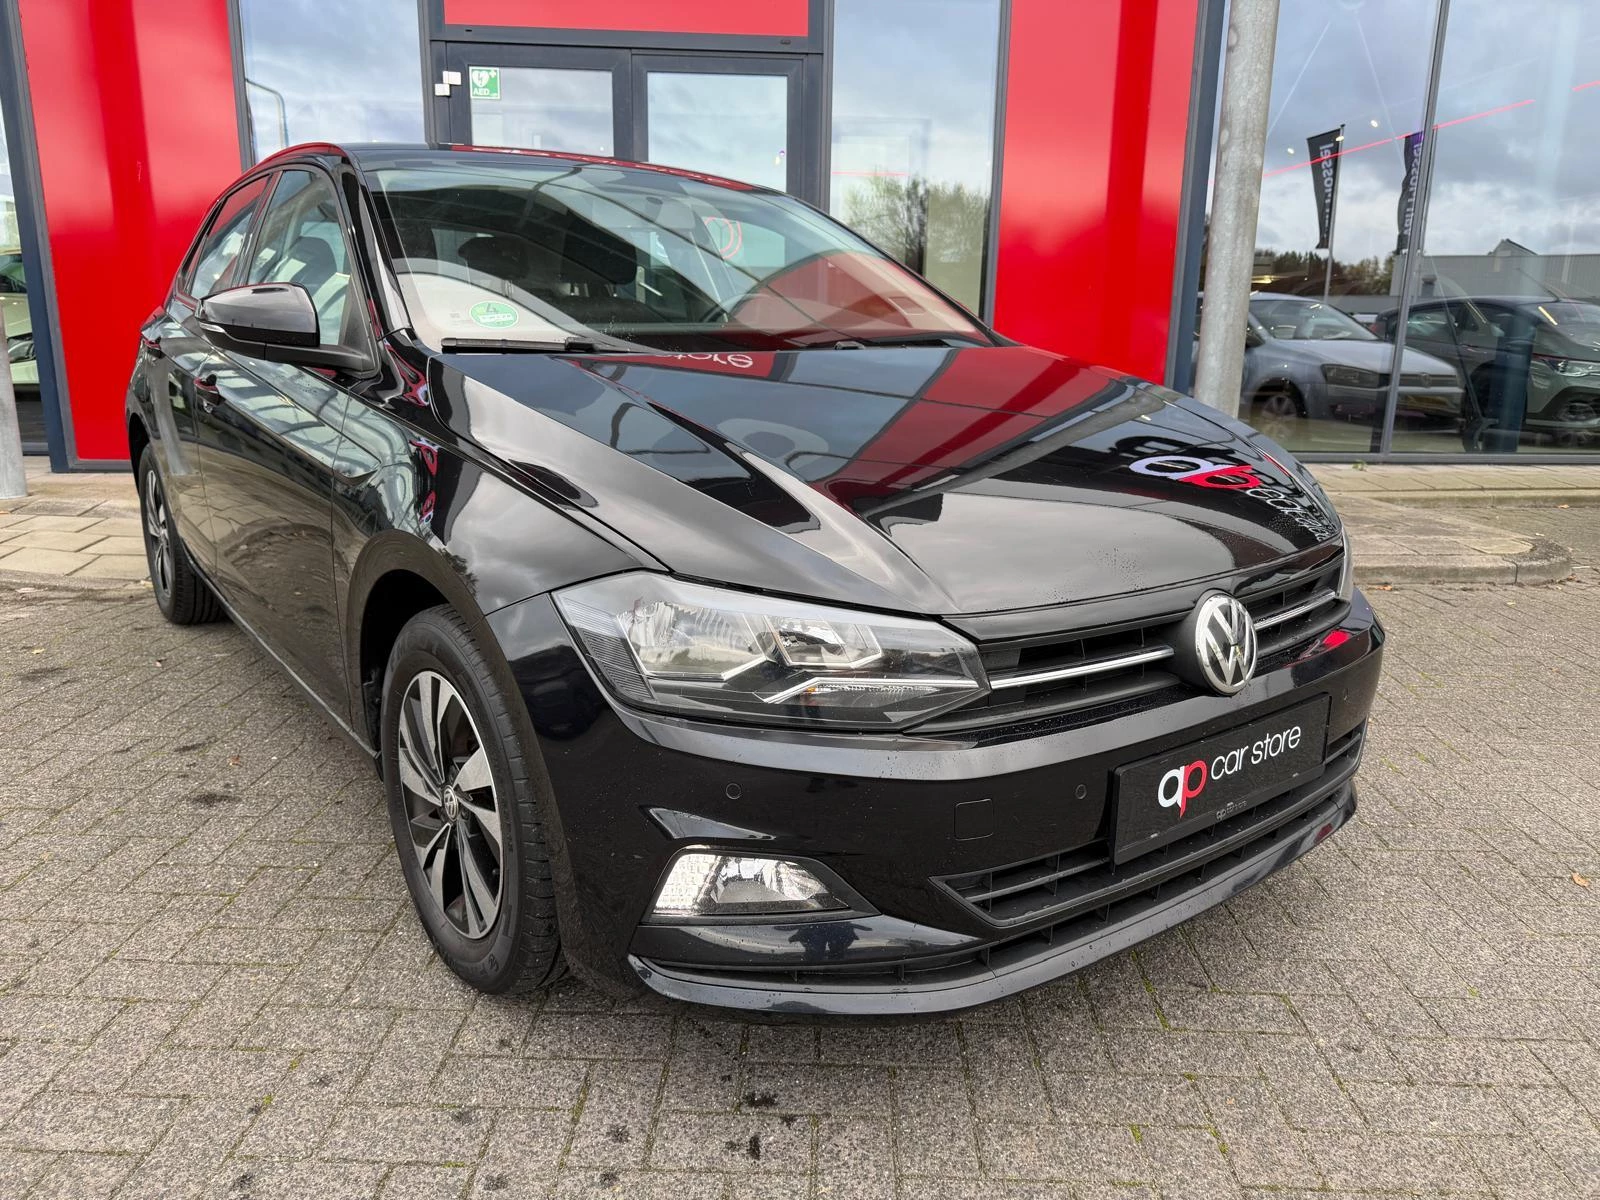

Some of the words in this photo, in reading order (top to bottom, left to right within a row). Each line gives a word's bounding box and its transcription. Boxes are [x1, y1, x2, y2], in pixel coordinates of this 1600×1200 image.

[473, 87, 490, 96] AED
[1211, 746, 1249, 780] car
[1251, 726, 1301, 765] store
